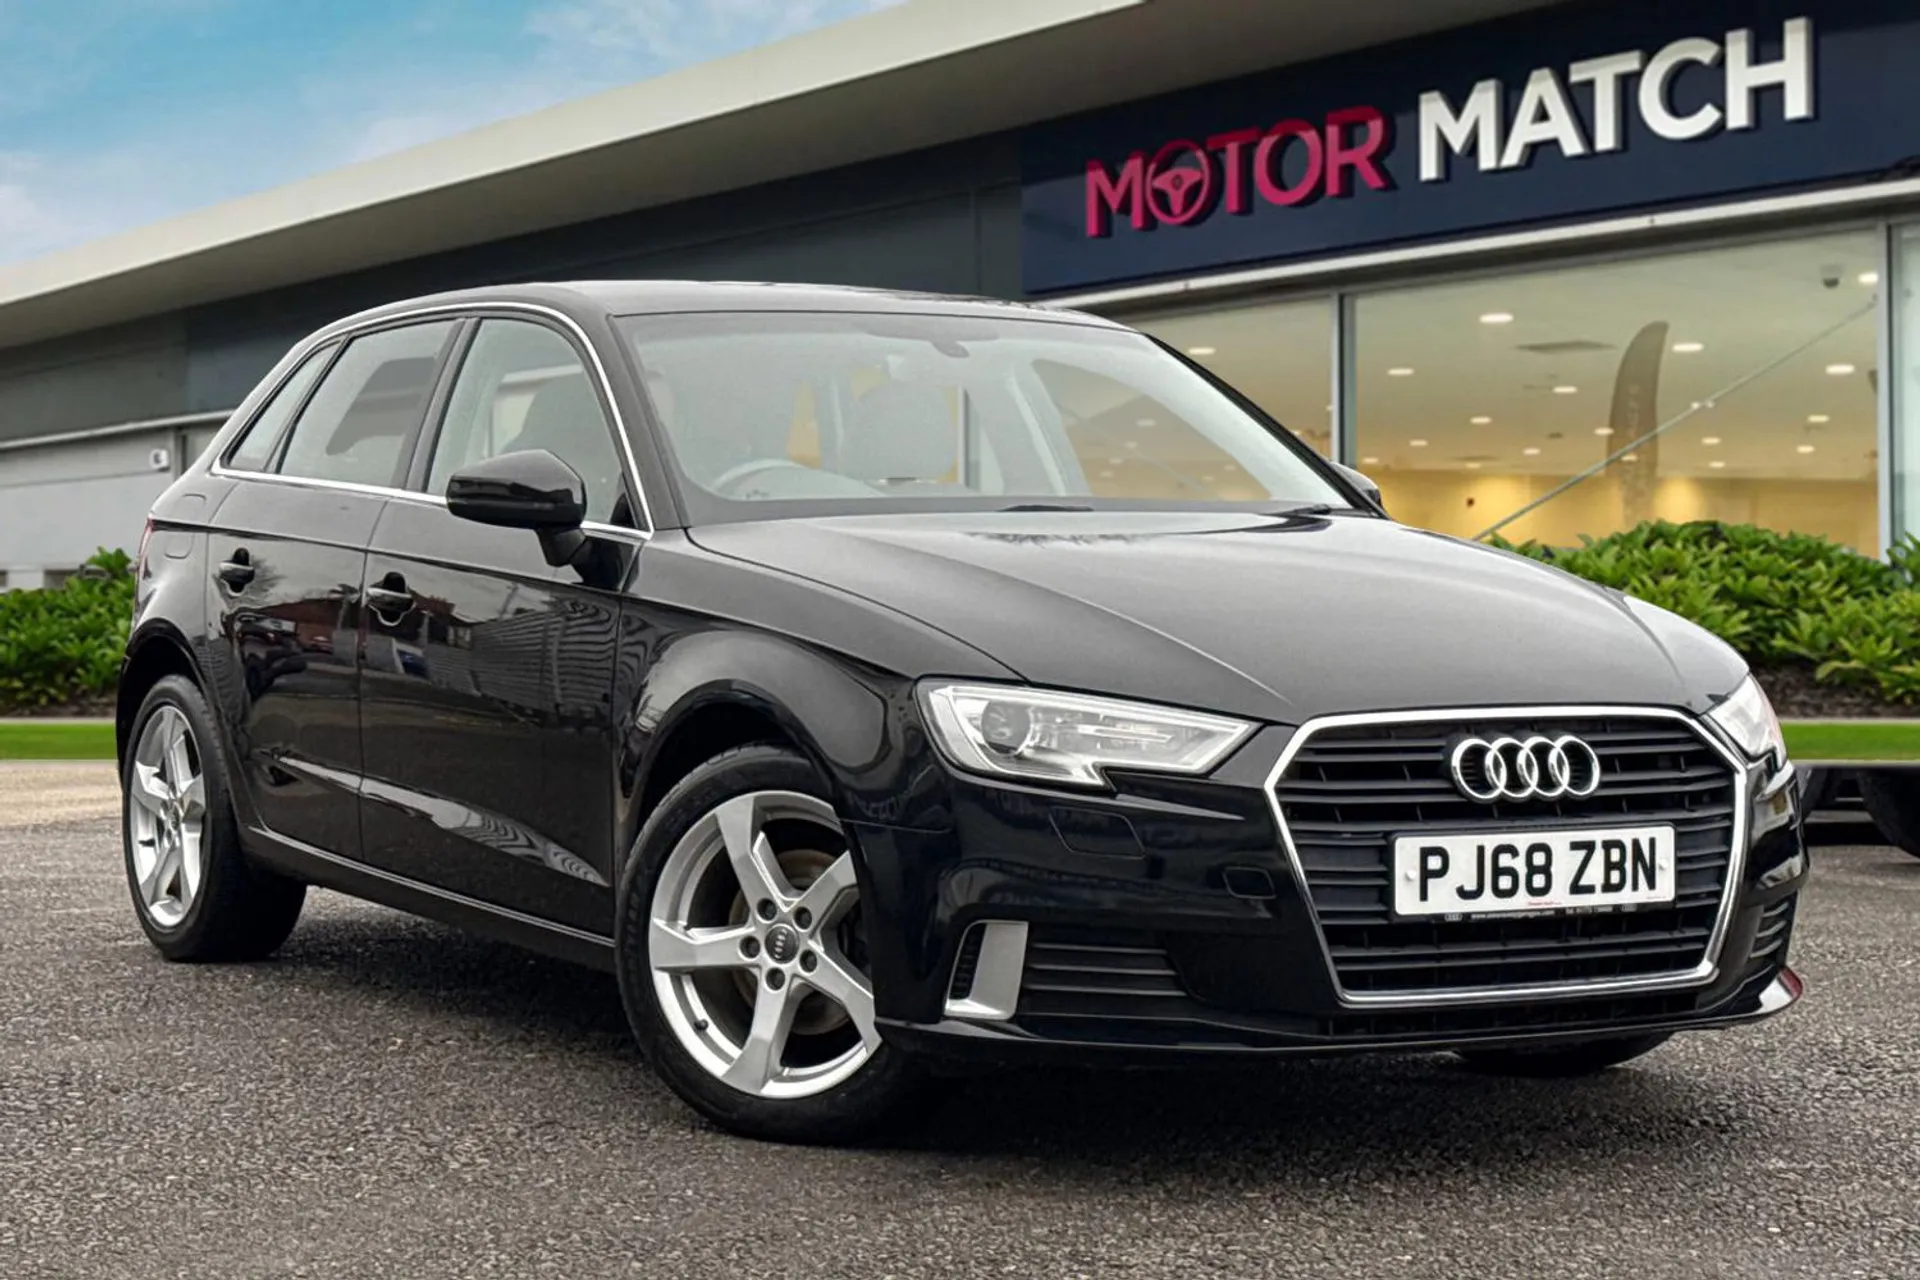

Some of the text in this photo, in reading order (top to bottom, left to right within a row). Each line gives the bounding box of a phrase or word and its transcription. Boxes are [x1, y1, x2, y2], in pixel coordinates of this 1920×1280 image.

[1086, 17, 1812, 237] MOTOR MATCH
[1419, 837, 1656, 902] PJ68 ZBN
